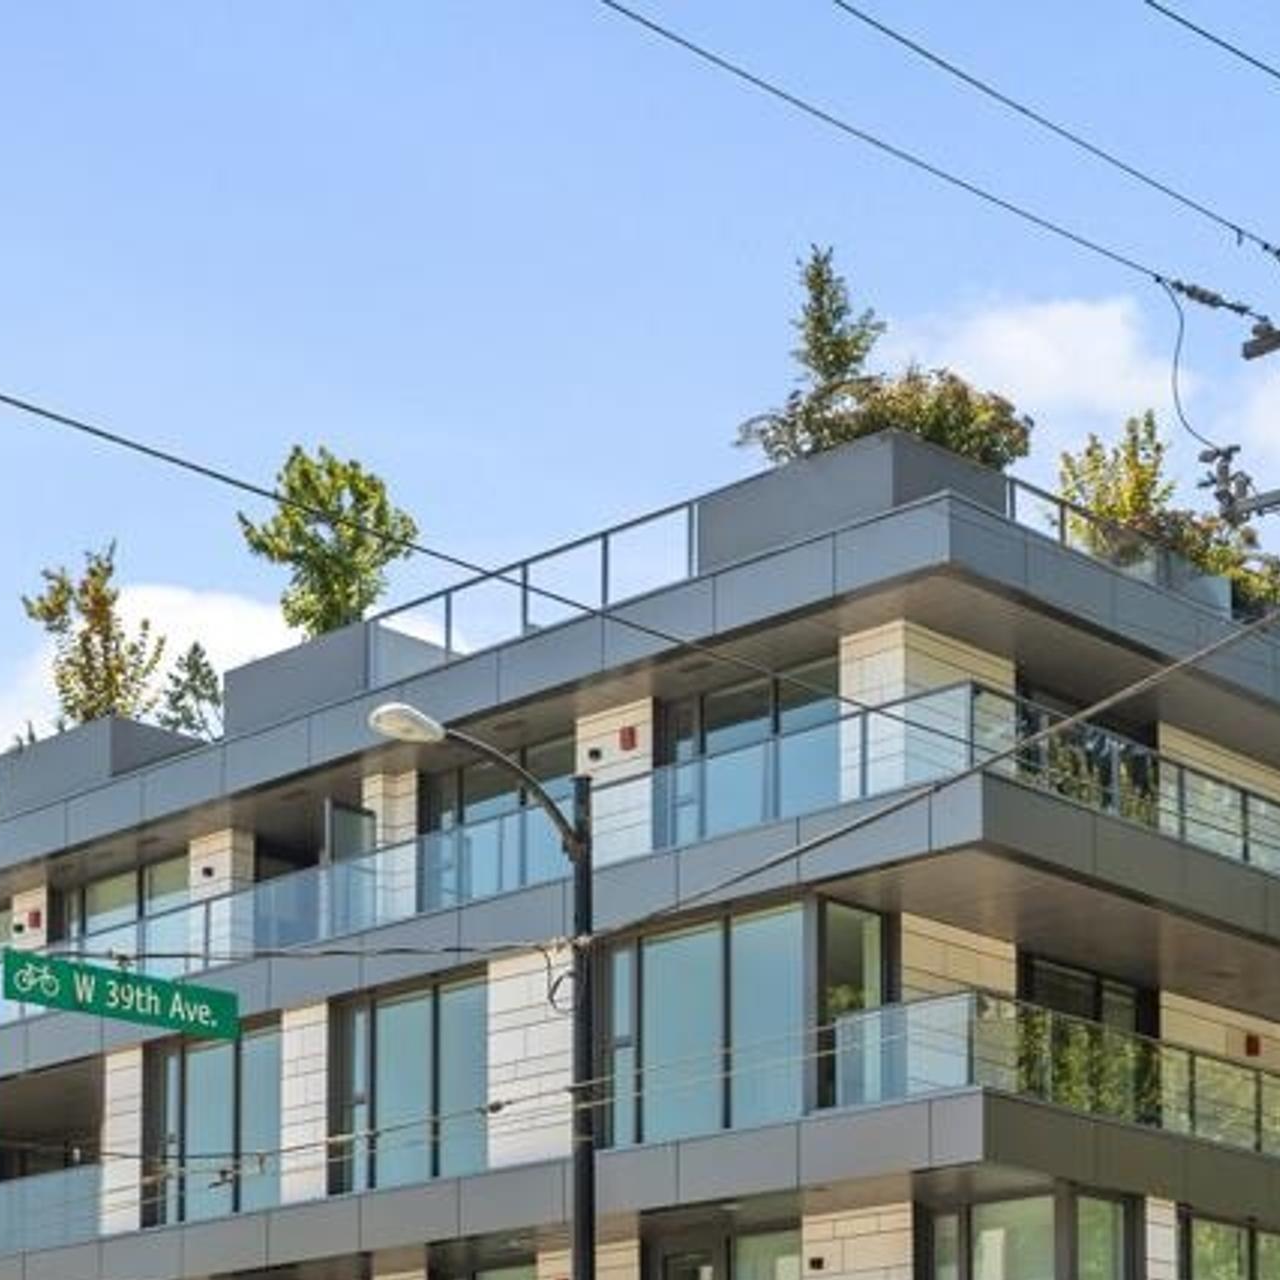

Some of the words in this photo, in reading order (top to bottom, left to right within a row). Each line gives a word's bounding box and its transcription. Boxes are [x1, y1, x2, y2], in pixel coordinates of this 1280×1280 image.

[73, 971, 96, 1003] W
[106, 980, 161, 1016] 39th
[170, 991, 218, 1028] Ave.
